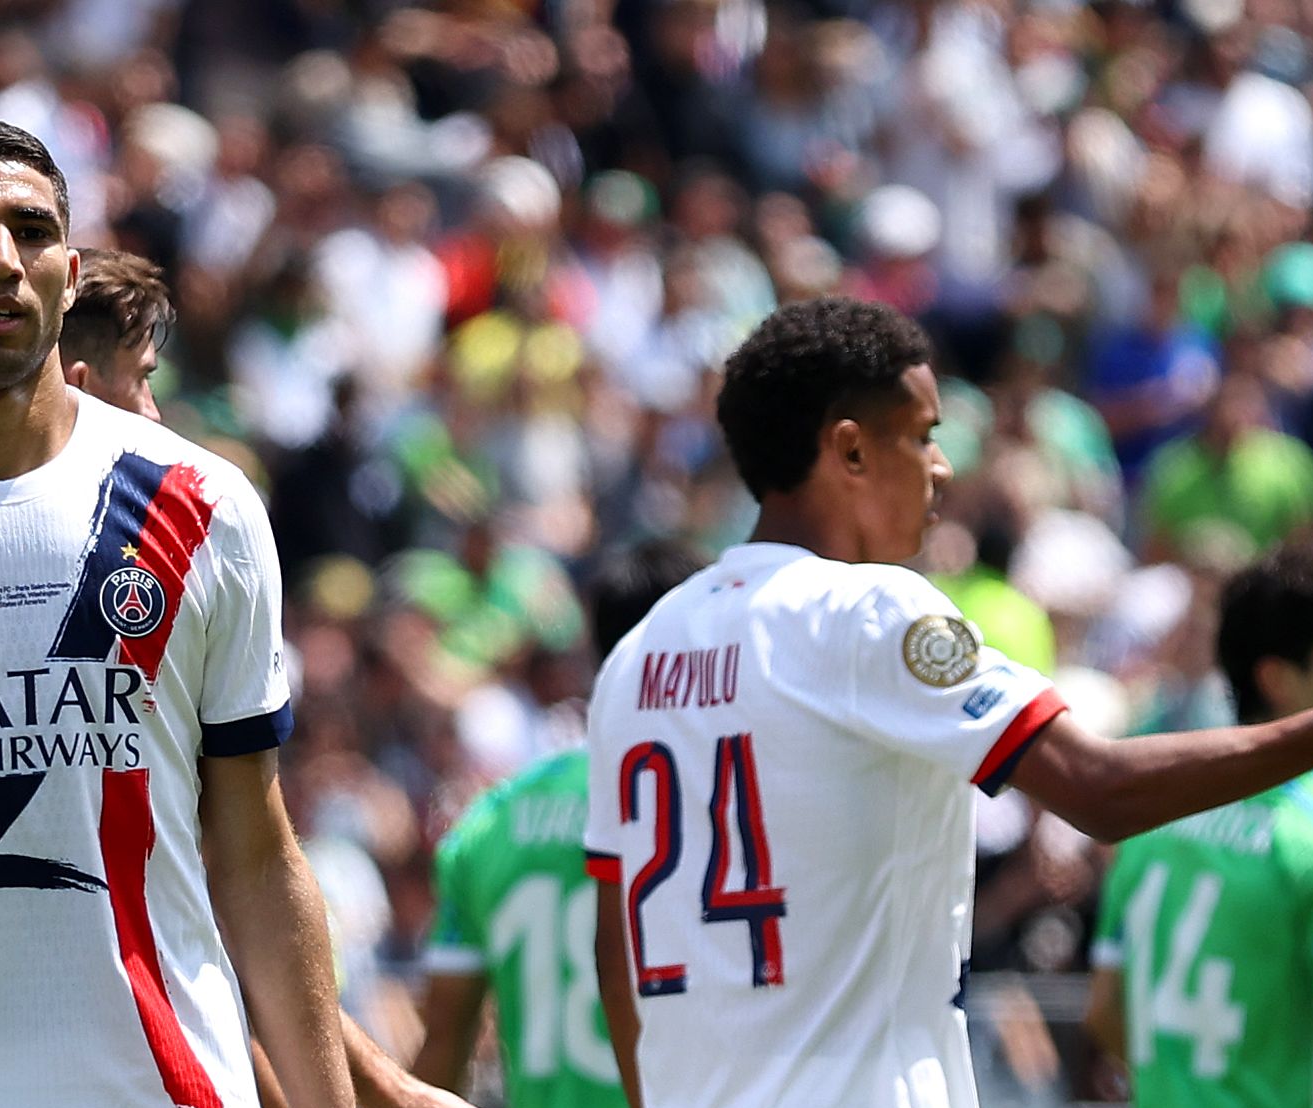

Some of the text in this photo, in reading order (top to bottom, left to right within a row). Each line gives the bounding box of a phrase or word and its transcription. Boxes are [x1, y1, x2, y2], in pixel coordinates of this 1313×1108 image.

[111, 571, 155, 589] PARIS
[638, 643, 740, 710] MAYULU
[620, 732, 788, 997] 24
[488, 872, 619, 1080] 18
[1125, 861, 1245, 1080] 14
